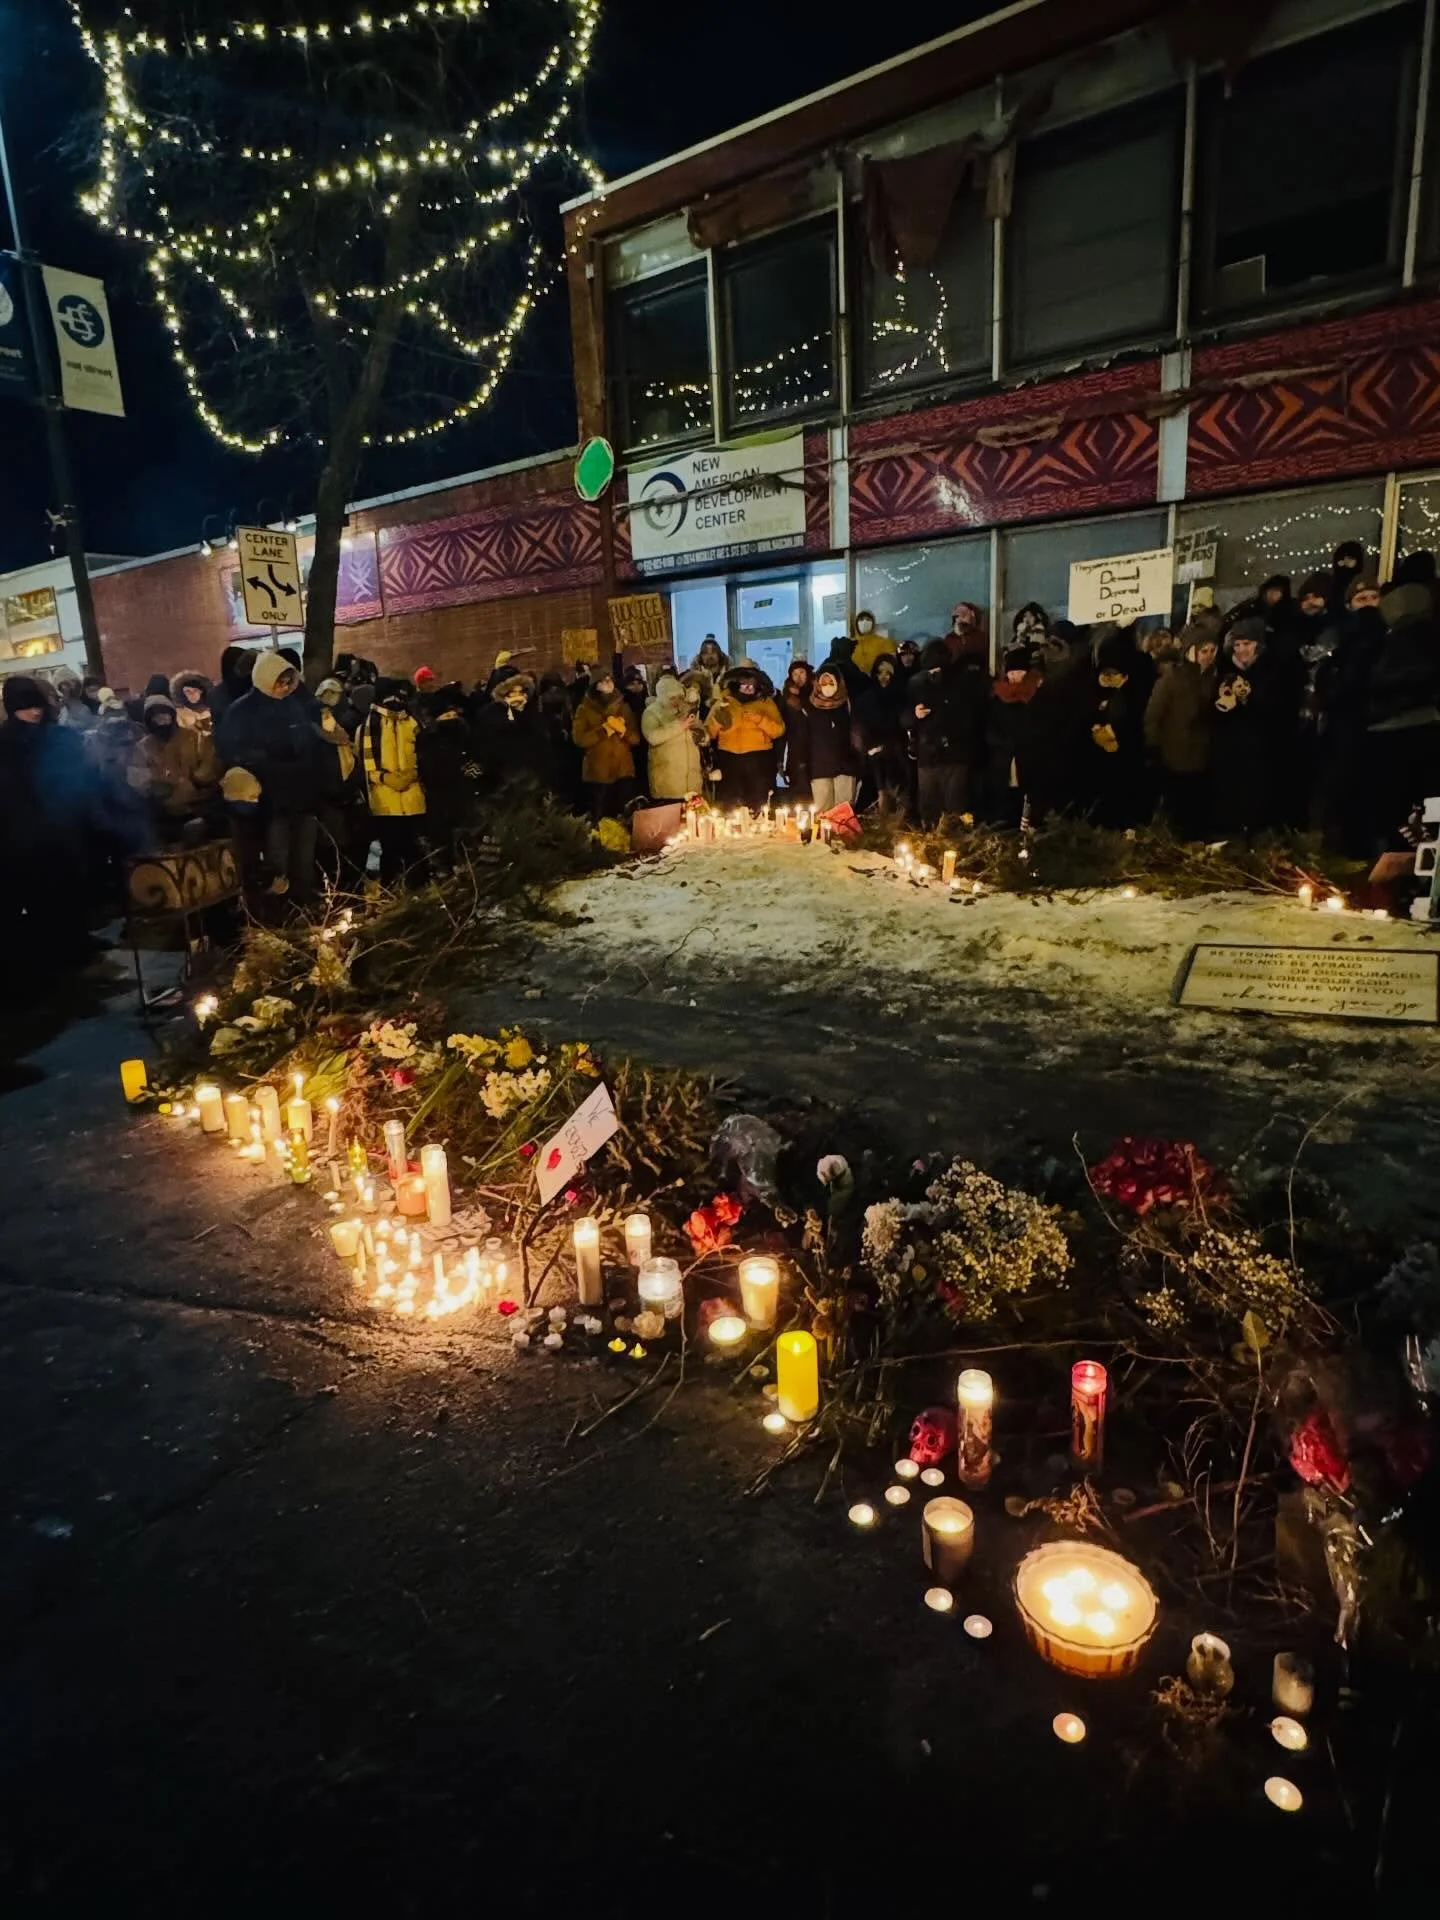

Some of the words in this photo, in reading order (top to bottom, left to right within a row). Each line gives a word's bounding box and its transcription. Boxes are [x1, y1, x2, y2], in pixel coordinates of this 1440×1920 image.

[693, 456, 720, 474] NEW
[694, 466, 760, 493] AMERICAN
[695, 484, 789, 512] DEVELOPMENT
[695, 509, 746, 530] CENTER
[245, 533, 288, 546] CENTER
[253, 547, 284, 558] LANE
[261, 611, 288, 621] ONLY
[638, 597, 662, 619] ICE
[1096, 611, 1106, 619] or
[1111, 598, 1146, 617] Dead
[640, 617, 664, 642] OUT
[1230, 950, 1283, 959] STRONG
[1296, 952, 1396, 963] COURAGEOUS
[1312, 977, 1351, 985] YOUR
[1314, 969, 1421, 980] DISCOURAGED
[1267, 982, 1298, 990] WILL
[1328, 986, 1369, 994] WITH
[1373, 988, 1406, 996] YOU
[1222, 985, 1321, 1003] wherever
[1328, 999, 1384, 1013] you
[1385, 1001, 1424, 1017] go
